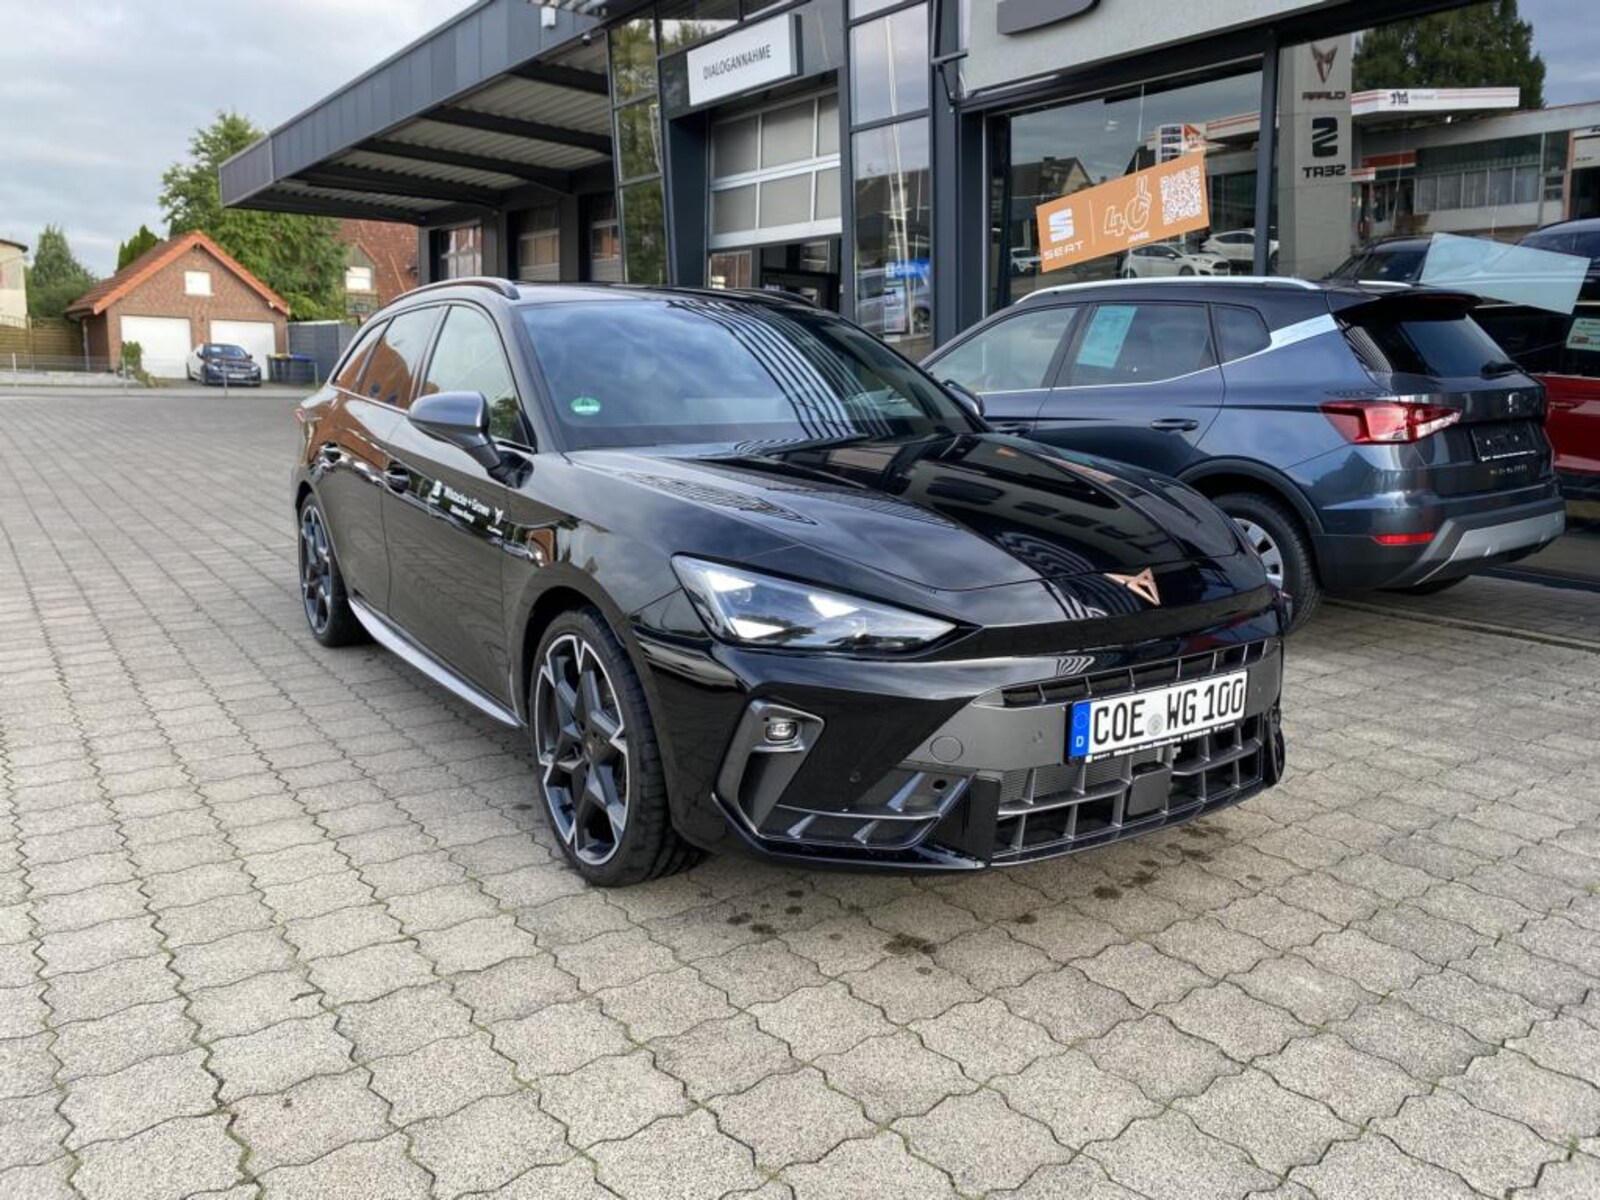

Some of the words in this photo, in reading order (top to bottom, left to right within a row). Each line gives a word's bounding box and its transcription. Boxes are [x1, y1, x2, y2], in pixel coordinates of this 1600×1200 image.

[703, 44, 771, 80] DIALOGANNAHME
[1043, 240, 1084, 261] SEAT
[1093, 699, 1146, 745] COE
[1075, 735, 1085, 748] D
